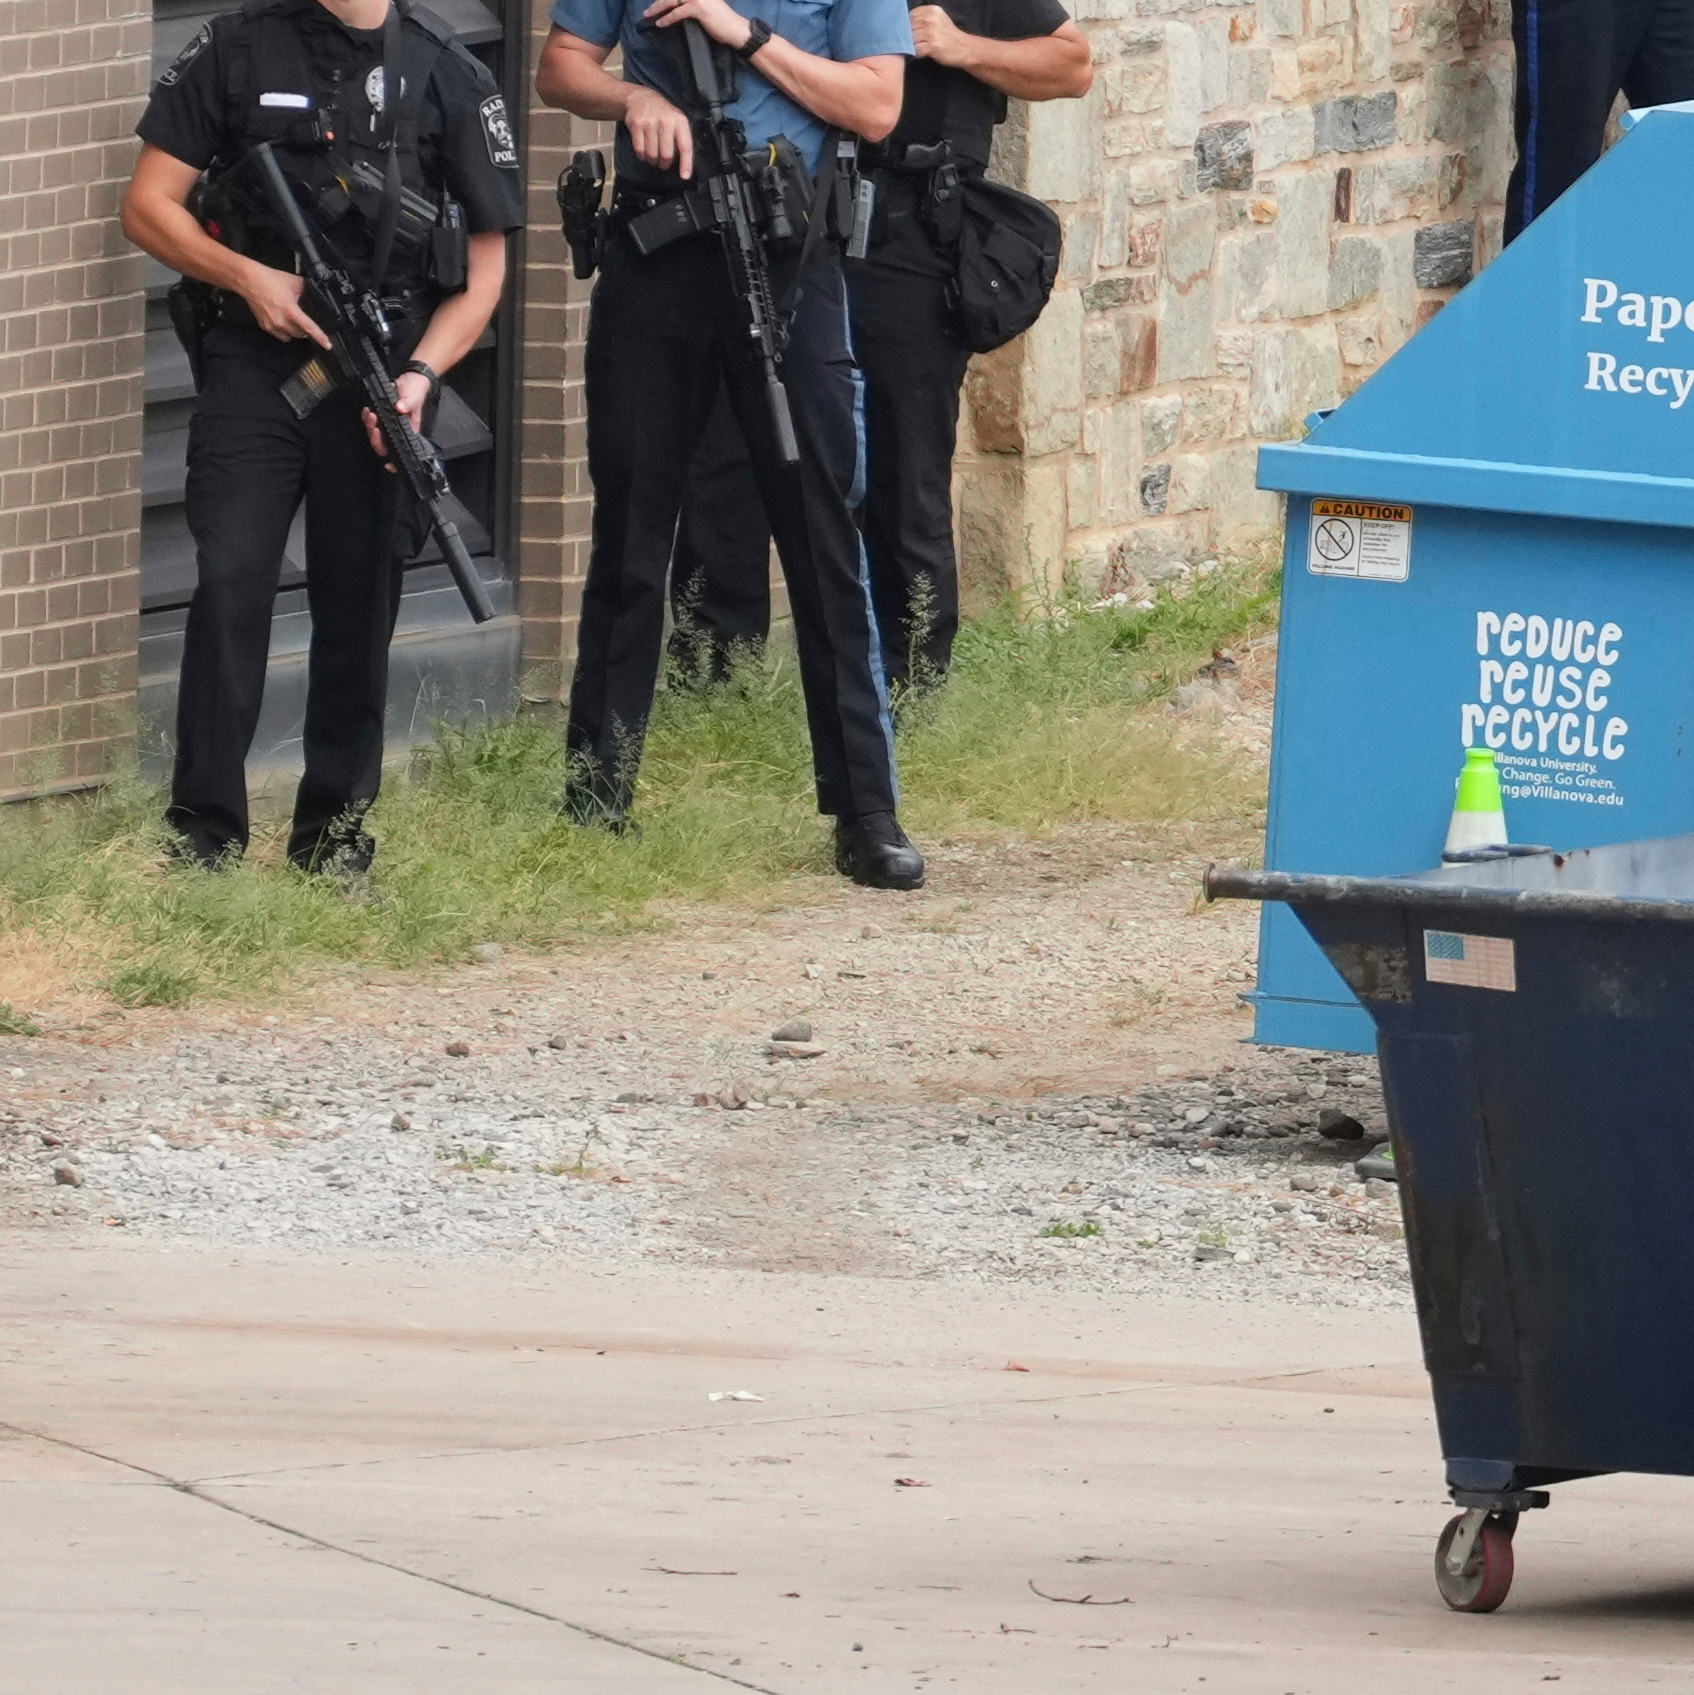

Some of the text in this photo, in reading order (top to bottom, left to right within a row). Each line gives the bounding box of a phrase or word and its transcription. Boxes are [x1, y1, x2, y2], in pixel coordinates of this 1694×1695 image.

[482, 99, 504, 117] RAD
[494, 150, 516, 163] POL
[1333, 503, 1404, 520] CAUTION
[1494, 751, 1598, 775] illanova University.
[1502, 766, 1616, 790] Change. Go Green.
